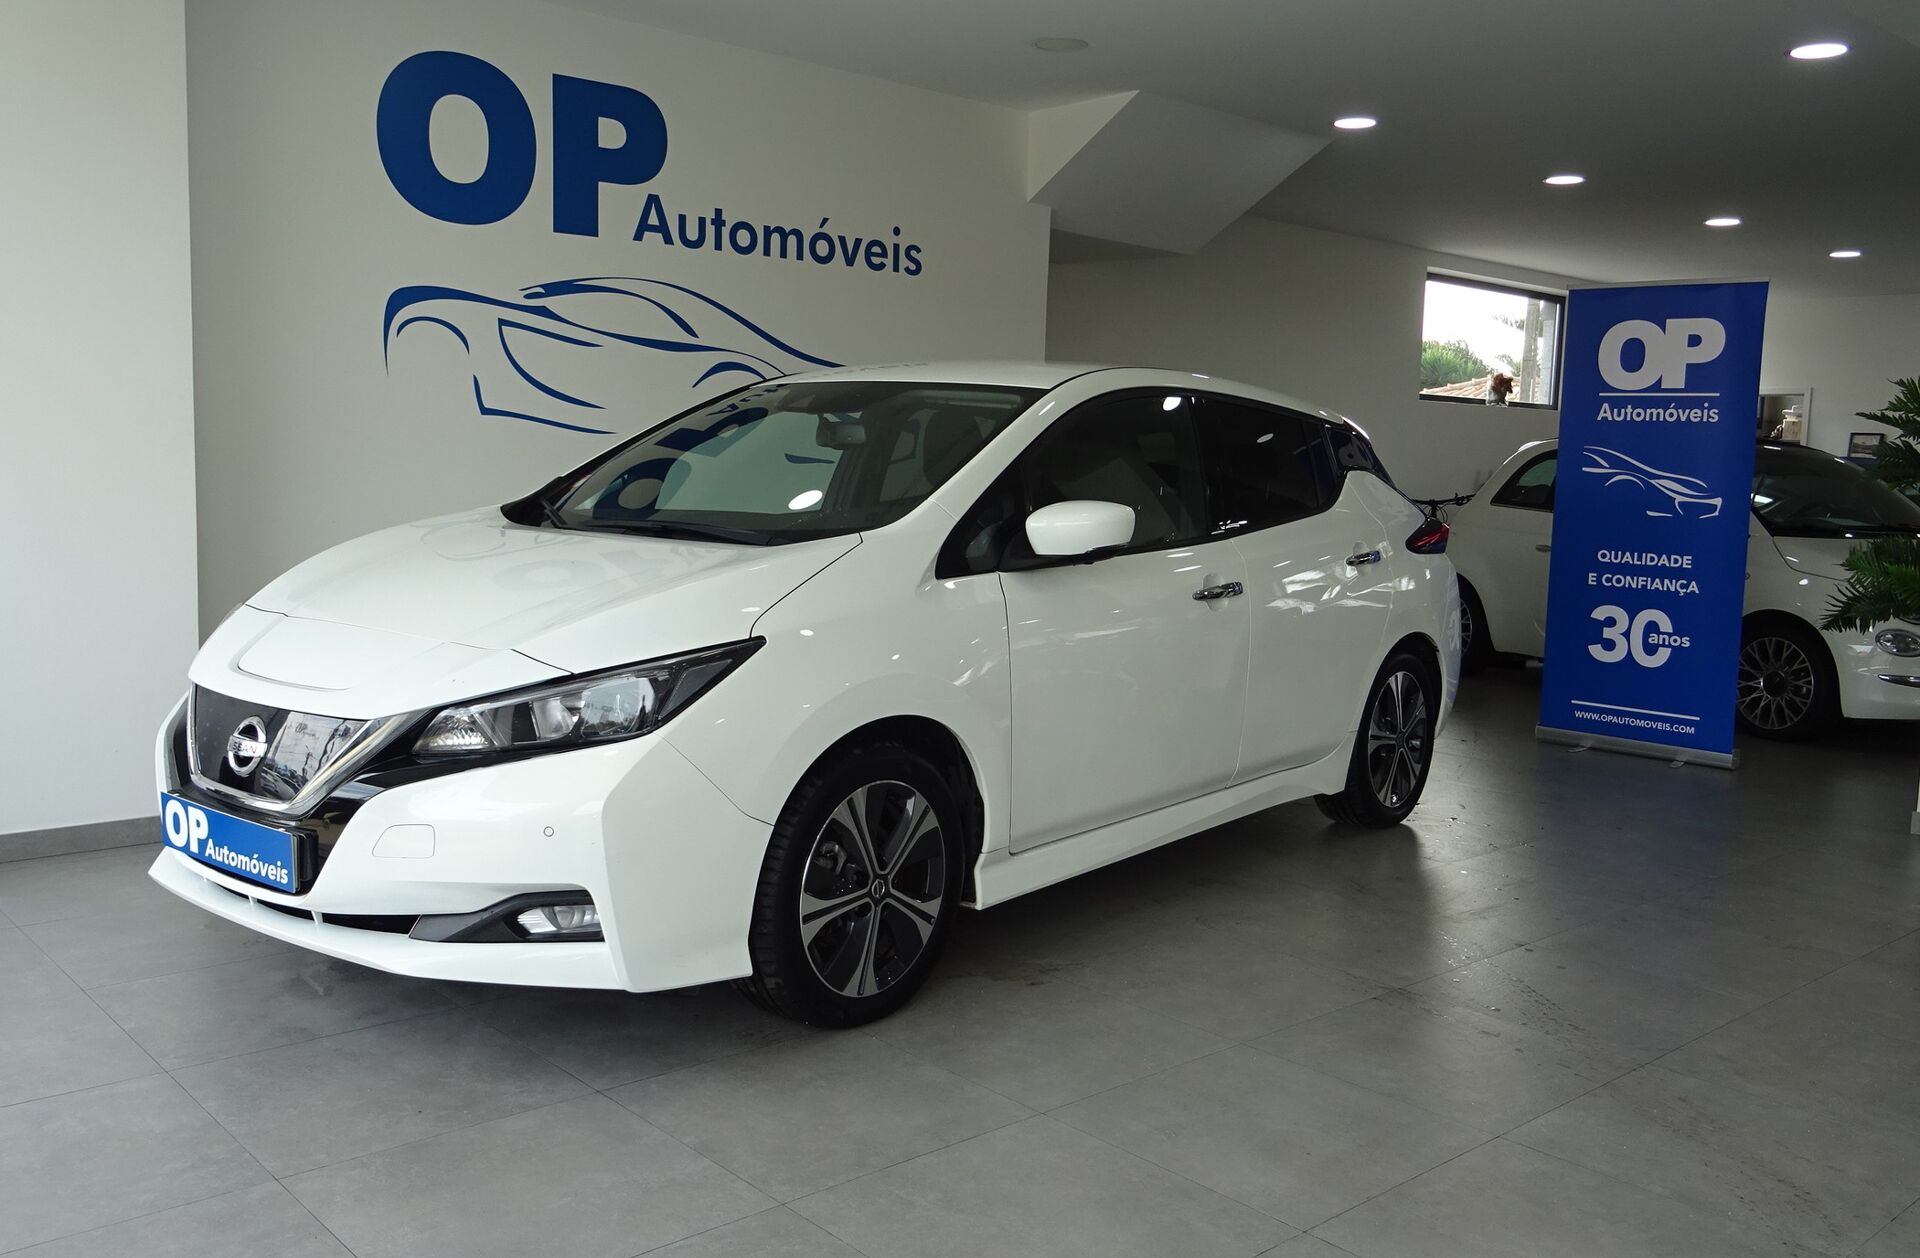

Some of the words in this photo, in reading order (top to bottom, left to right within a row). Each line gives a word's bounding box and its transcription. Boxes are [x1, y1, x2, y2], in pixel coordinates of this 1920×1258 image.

[377, 50, 668, 238] OP
[632, 193, 923, 276] Automóveis
[1597, 317, 1727, 391] OP
[1597, 402, 1720, 423] Automóveis
[1597, 549, 1693, 569] QUALIDADE
[1587, 572, 1597, 585] E
[1601, 573, 1700, 596] CONFIANÇA
[1587, 604, 1674, 668] 30
[1647, 632, 1691, 648] anos
[1573, 710, 1696, 735] WWW.OPAUTOMOVEIS.COM
[164, 799, 209, 855] OP
[204, 838, 289, 885] Automóveis
